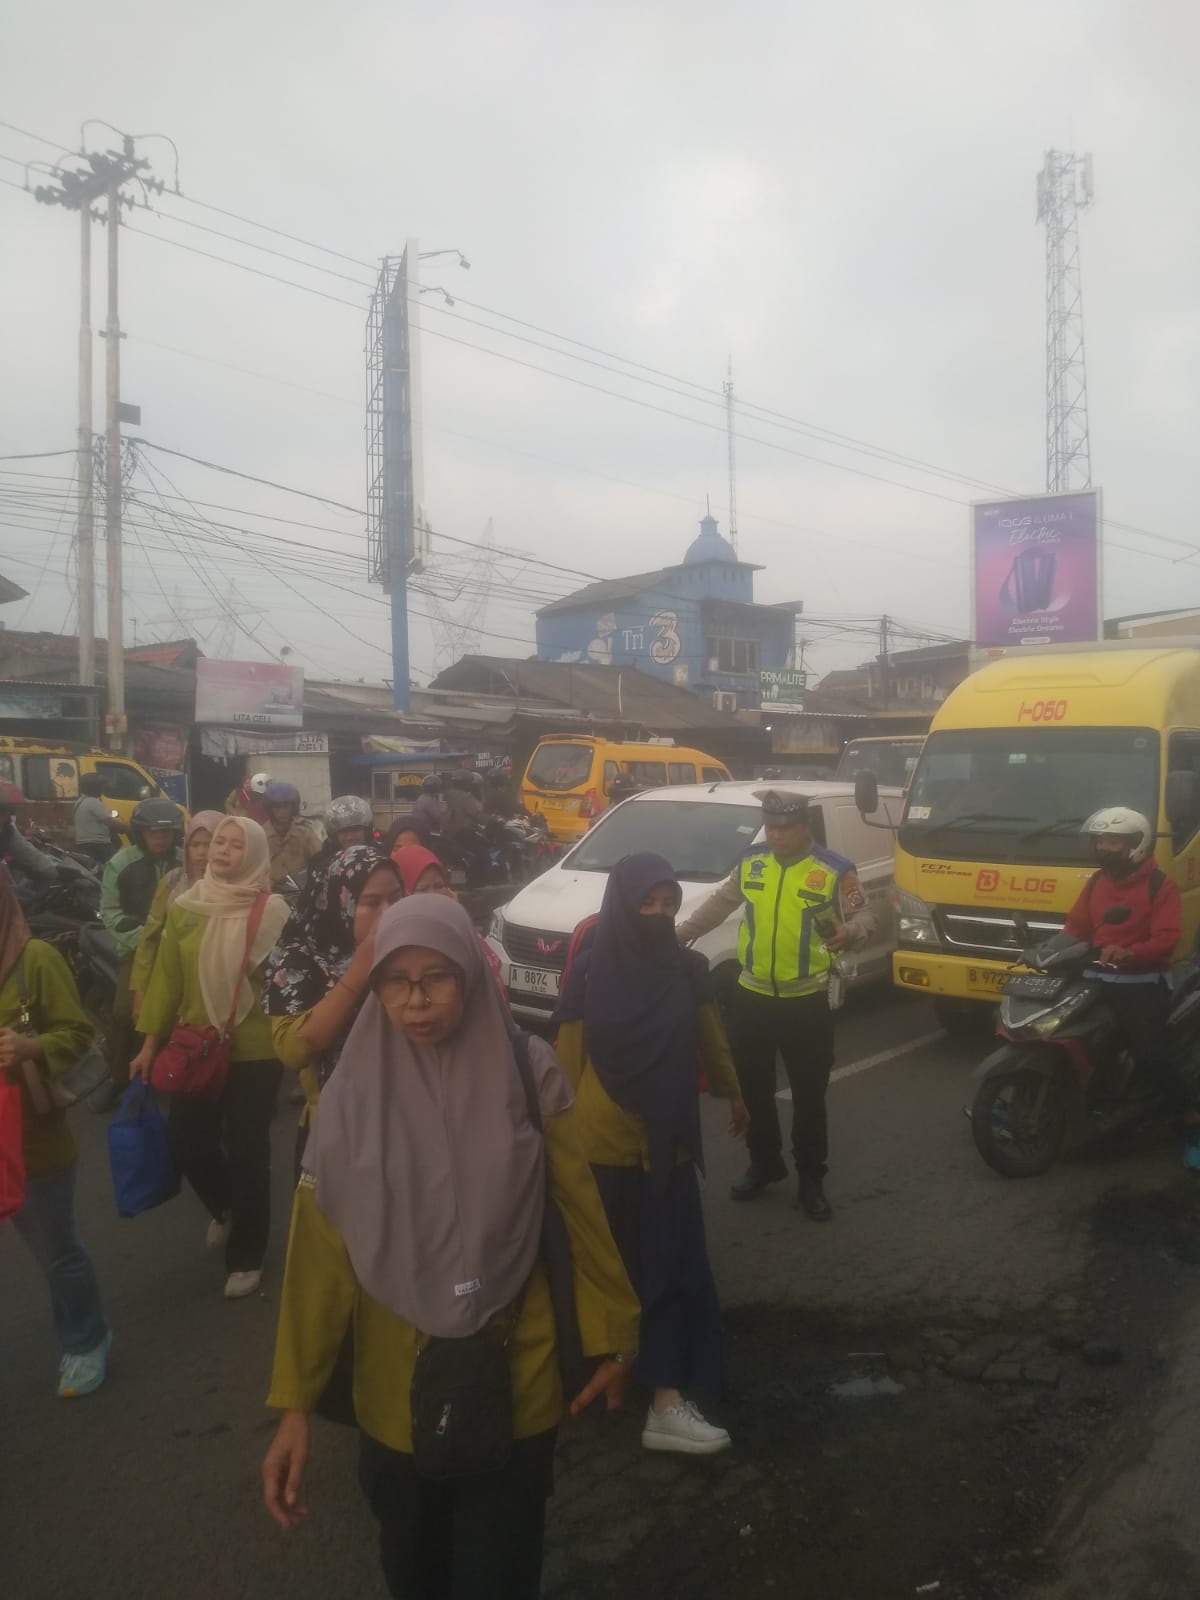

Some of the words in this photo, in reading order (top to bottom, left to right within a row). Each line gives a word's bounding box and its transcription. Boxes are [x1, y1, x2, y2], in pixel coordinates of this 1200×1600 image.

[622, 627, 644, 650] Tri
[649, 608, 682, 665] 3
[233, 713, 251, 722] LITA
[252, 714, 272, 723] CELL
[512, 969, 518, 982] A
[525, 971, 547, 986] 8874
[970, 969, 977, 982] B
